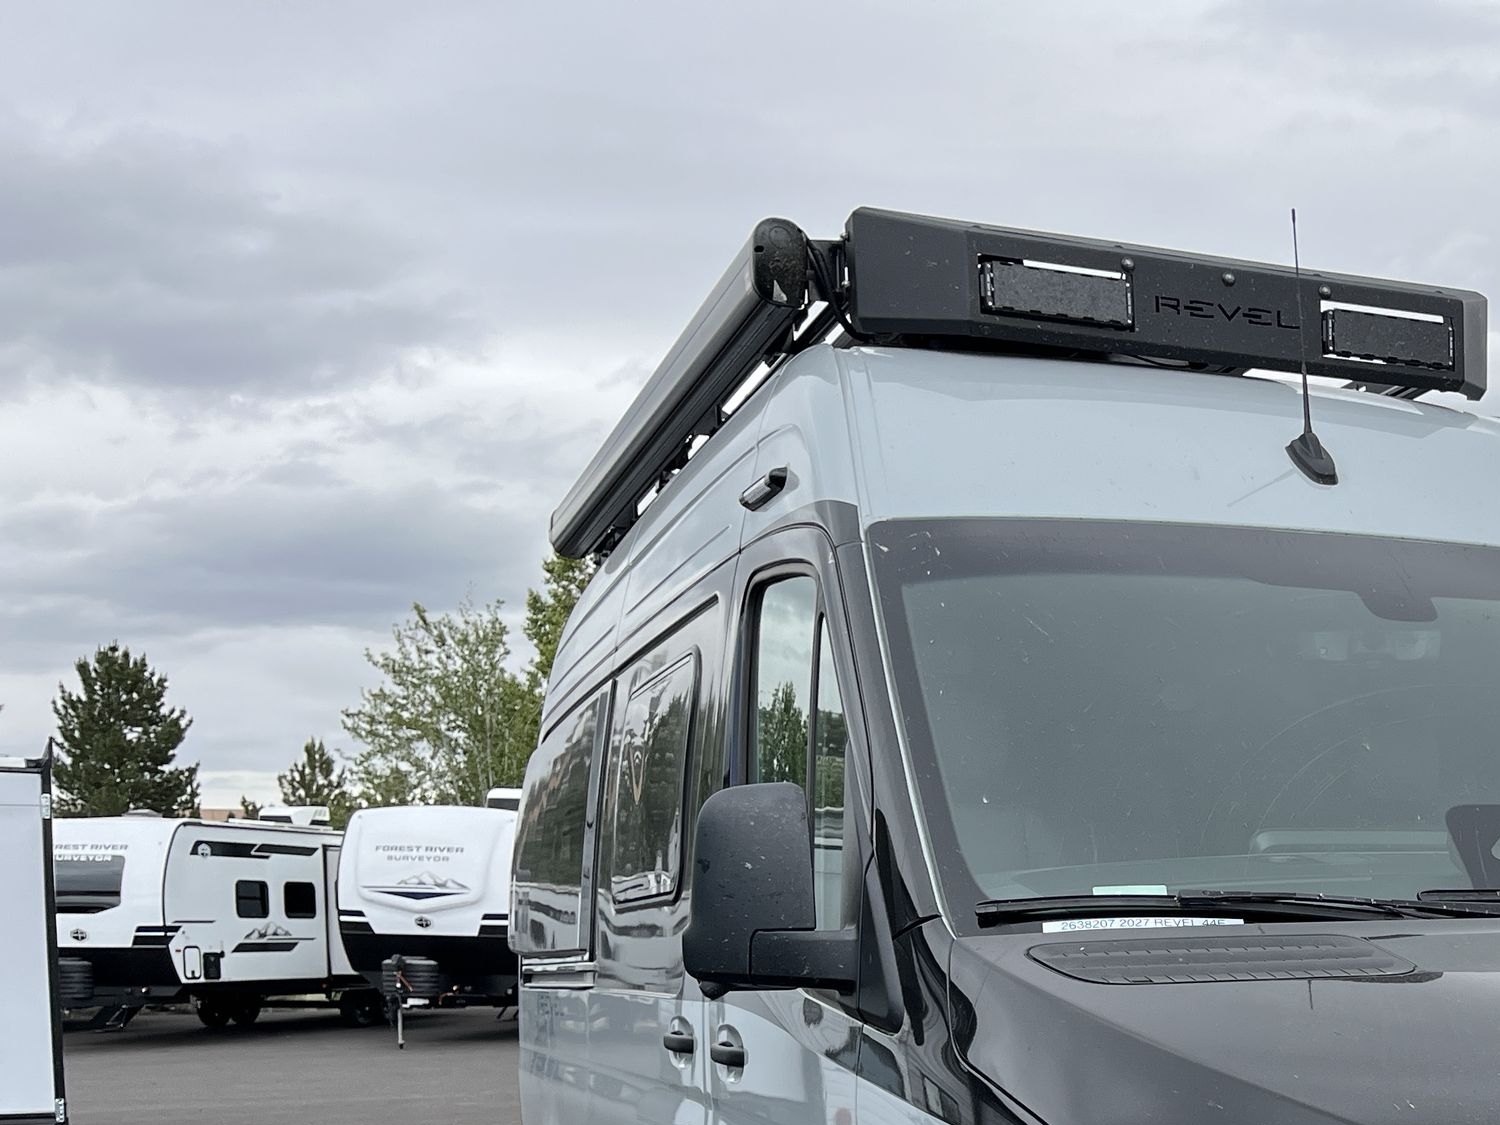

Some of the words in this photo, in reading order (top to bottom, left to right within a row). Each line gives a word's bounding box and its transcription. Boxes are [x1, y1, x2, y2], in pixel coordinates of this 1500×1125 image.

[1154, 295, 1300, 330] REVEL
[375, 844, 422, 853] FOREST
[424, 845, 465, 853] RIVER
[54, 854, 112, 862] URVEYOR
[386, 854, 450, 862] SURVEYOR
[1061, 918, 1116, 931] 2638207
[1119, 918, 1150, 928] 2027
